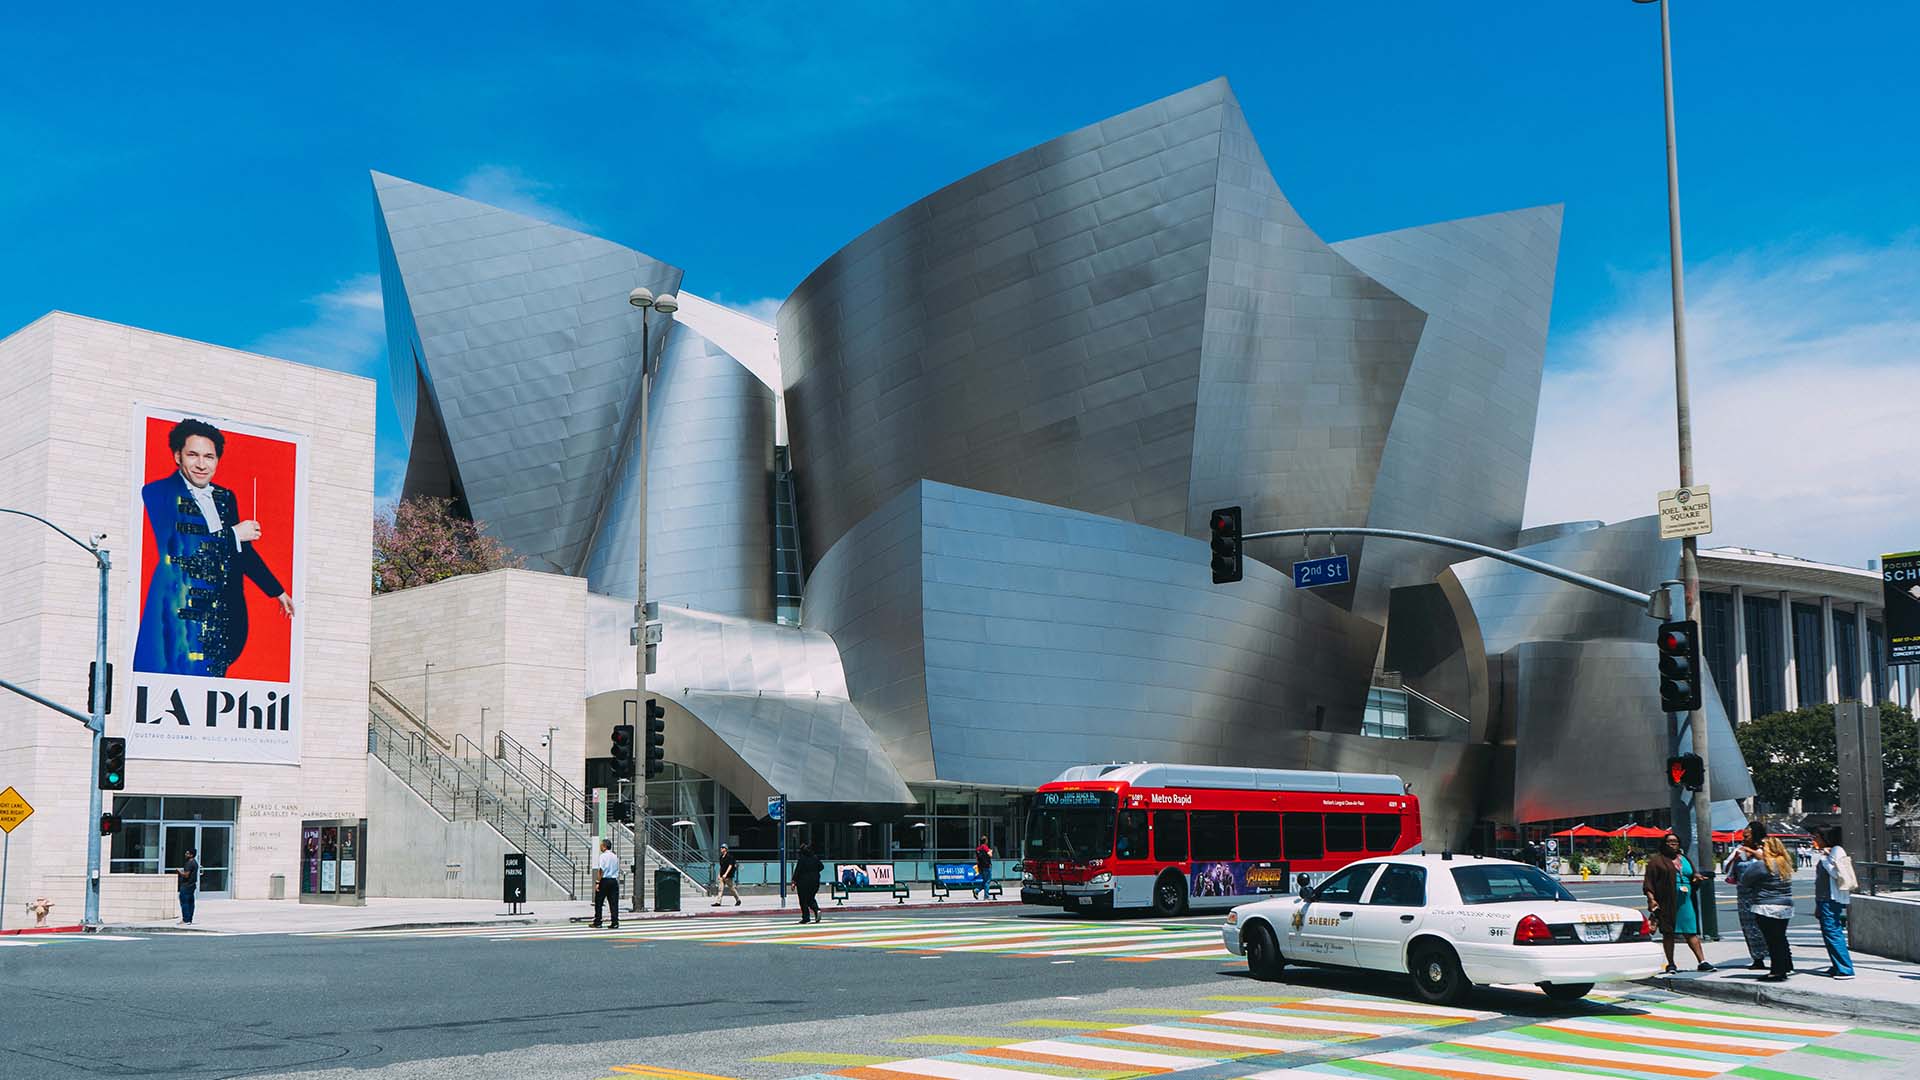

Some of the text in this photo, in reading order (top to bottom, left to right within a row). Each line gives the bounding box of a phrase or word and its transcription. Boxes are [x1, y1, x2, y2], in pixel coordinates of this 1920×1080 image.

[1662, 503, 1708, 515] JOEL WACHS
[1670, 511, 1700, 521] SQUARE
[1301, 563, 1342, 583] 2nd St
[1884, 568, 1920, 581] SCH
[135, 685, 290, 731] LA Phil
[1043, 793, 1059, 804] 760
[1151, 793, 1192, 806] Metro Rapid
[873, 867, 890, 880] YMI
[1308, 916, 1341, 927] SHERIFF
[1580, 913, 1622, 924] SHERIFF
